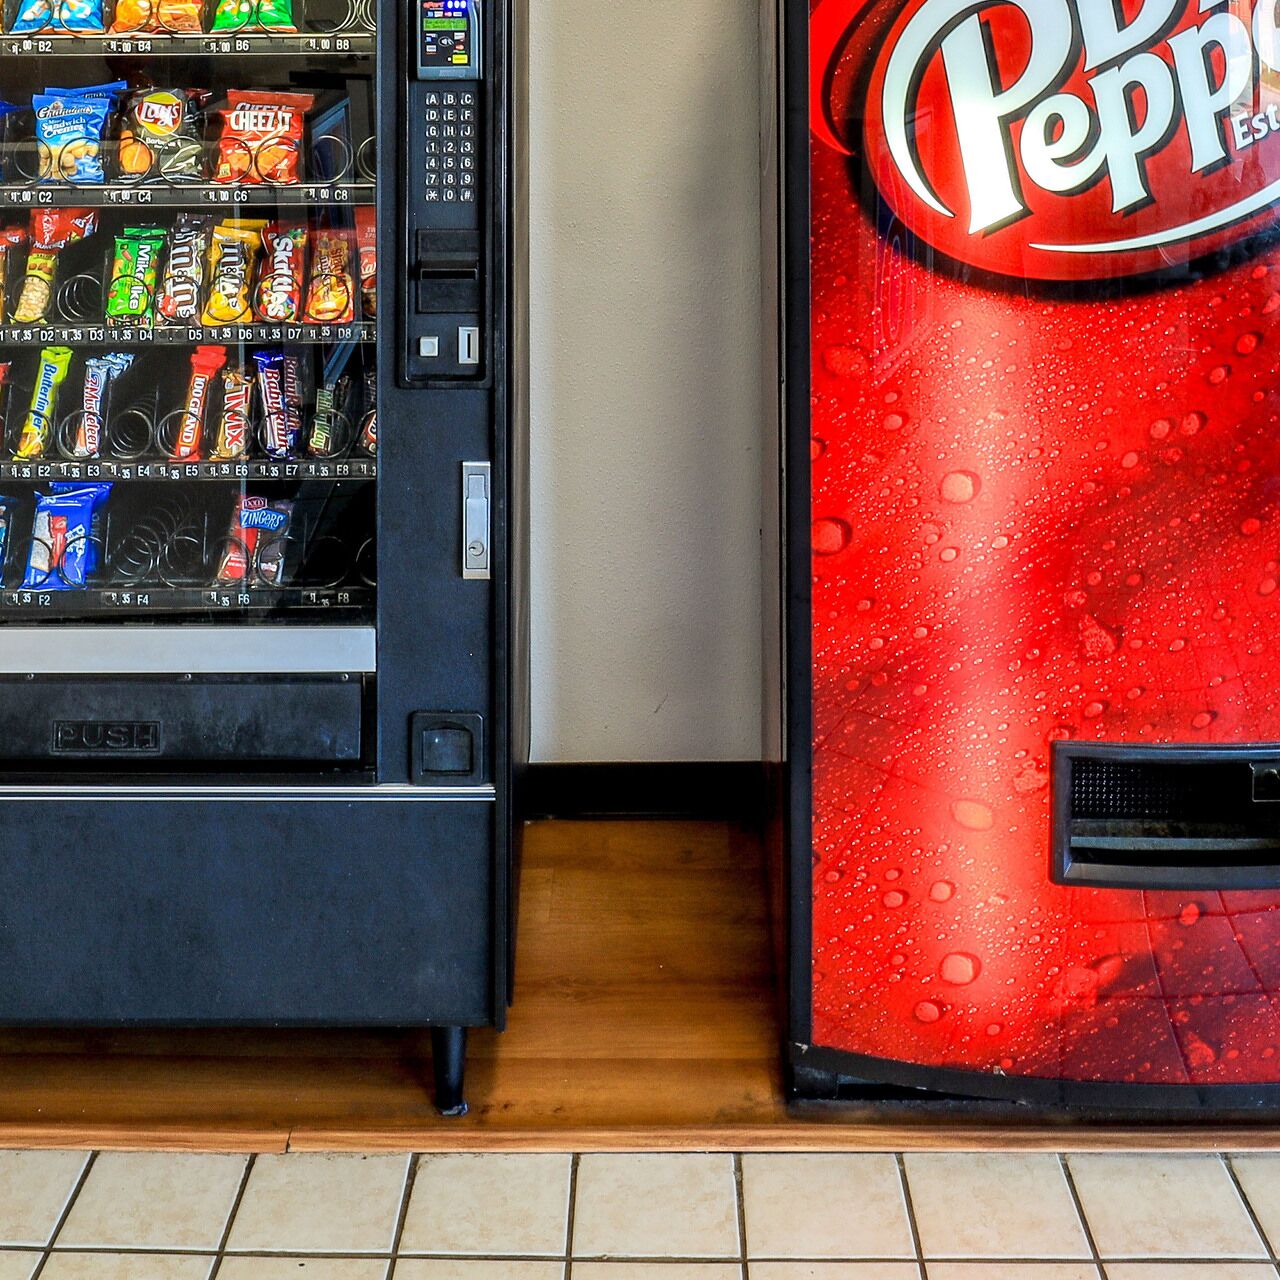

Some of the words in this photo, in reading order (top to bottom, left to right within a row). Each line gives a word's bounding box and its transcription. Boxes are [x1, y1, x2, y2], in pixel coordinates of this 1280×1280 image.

[38, 41, 53, 52] B2
[138, 41, 151, 52] B4
[235, 40, 250, 52] B6
[42, 116, 87, 131] Sandwich
[38, 191, 53, 203] C2
[138, 191, 152, 203] C4
[234, 191, 248, 202] C6
[335, 190, 348, 201] C8
[135, 244, 153, 282] Mike
[128, 285, 144, 310] Ike
[40, 331, 54, 342] D2
[90, 330, 103, 341] D3
[139, 330, 153, 341] D4
[188, 330, 202, 341] D5
[238, 329, 253, 340] D6
[288, 329, 301, 340] D7
[338, 328, 351, 339] D8
[224, 384, 249, 449] TWIX
[38, 466, 51, 477] E2
[88, 466, 100, 476] E3
[138, 465, 150, 477] E4
[185, 465, 198, 477] E5
[235, 465, 248, 476] E6
[285, 465, 298, 476] E7
[336, 464, 349, 476] E8
[38, 595, 51, 606] F2
[137, 594, 149, 606] F4
[238, 593, 250, 605] F6
[338, 593, 350, 604] F8
[58, 724, 155, 748] PUSH
